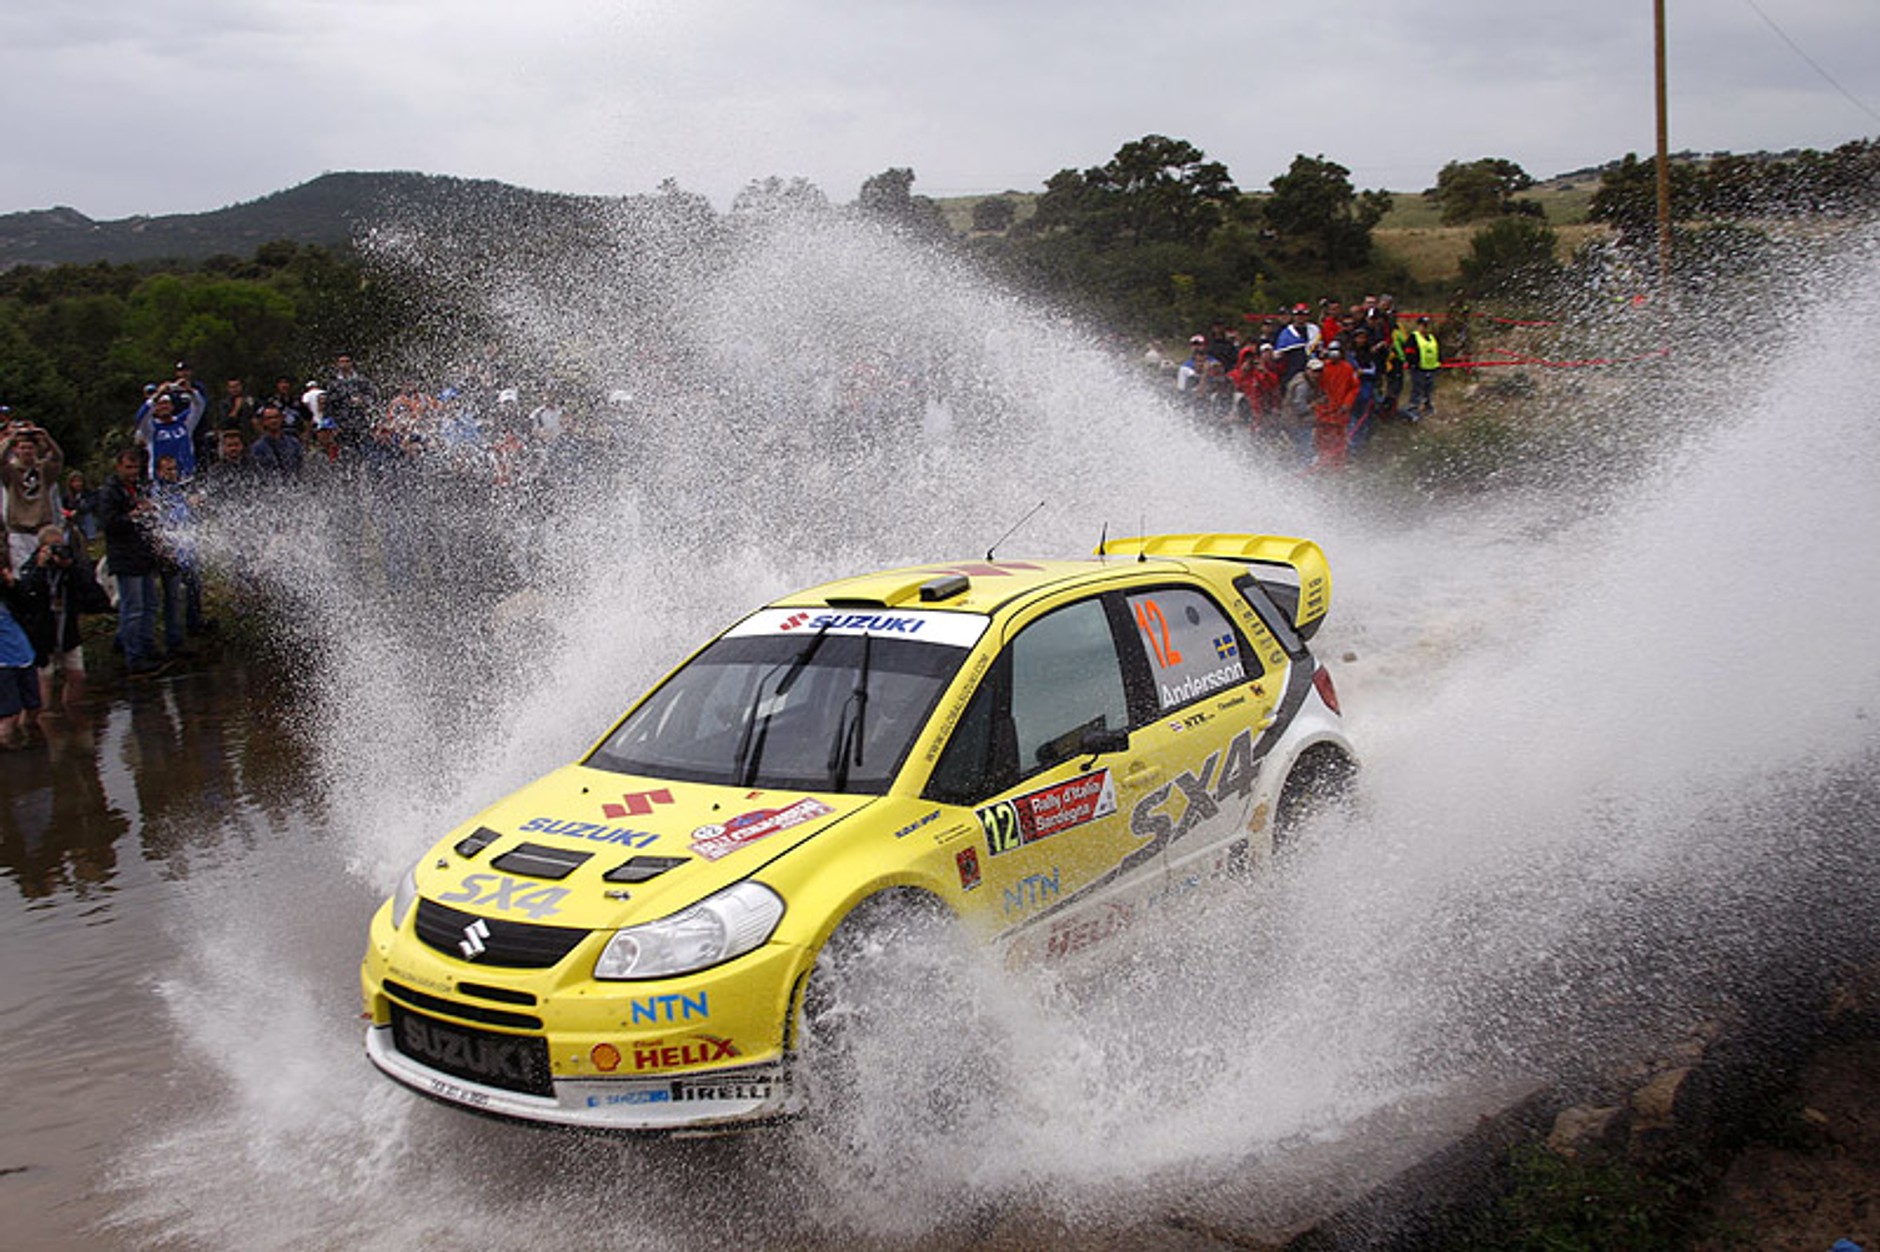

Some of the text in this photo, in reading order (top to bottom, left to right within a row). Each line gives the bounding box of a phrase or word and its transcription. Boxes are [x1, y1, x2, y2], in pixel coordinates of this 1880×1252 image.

[808, 614, 925, 633] SUZUKI
[1135, 598, 1183, 669] 12
[1160, 661, 1245, 709] Andersson
[1031, 794, 1062, 813] Rally
[1121, 727, 1263, 875] SX4
[519, 817, 661, 849] SUZUKI
[984, 803, 1020, 853] 12
[438, 873, 572, 920] SX4
[1003, 866, 1060, 914] NTN
[631, 991, 708, 1024] NTN
[634, 1037, 738, 1070] HELIX
[671, 1080, 771, 1102] PIRELLI
